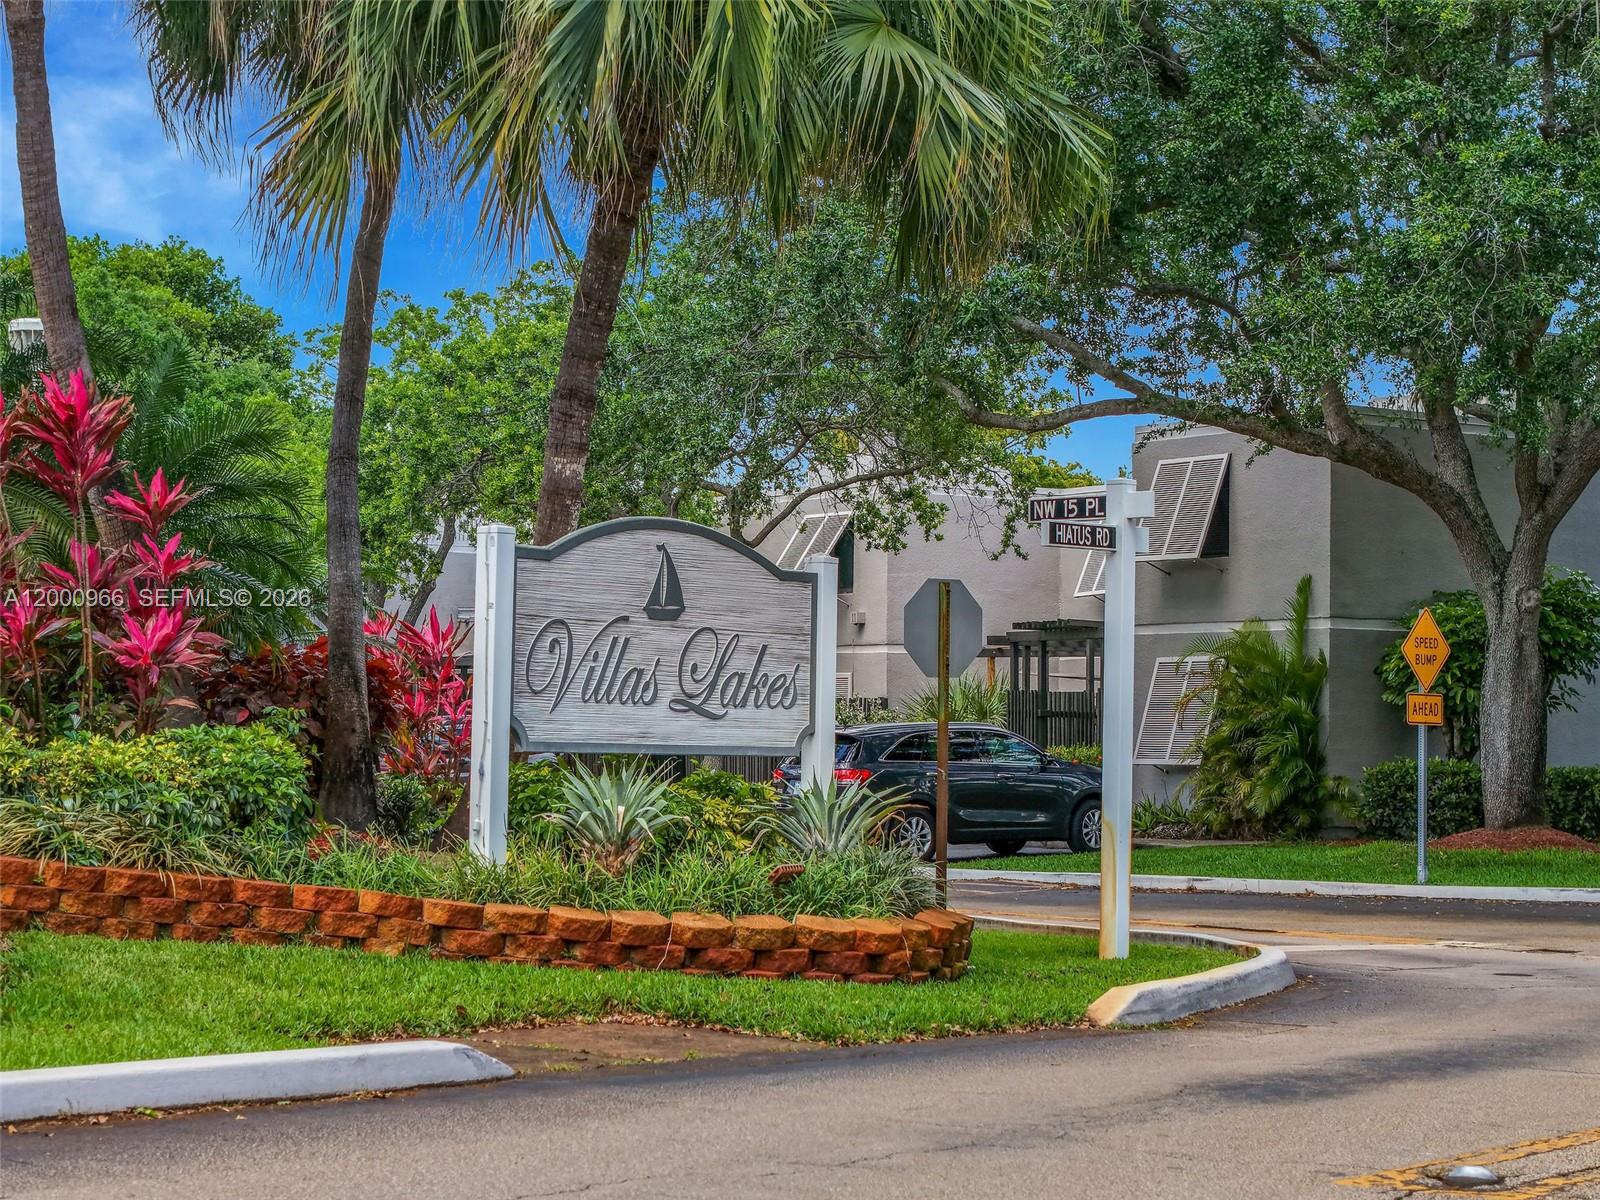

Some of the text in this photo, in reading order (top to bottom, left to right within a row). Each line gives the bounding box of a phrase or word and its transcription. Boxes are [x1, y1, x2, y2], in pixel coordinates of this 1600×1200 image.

[1033, 498, 1104, 518] NW 15 PL
[1056, 524, 1109, 546] HIATUS RD
[1414, 637, 1439, 649] SPEED
[525, 615, 801, 720] Villas Lakes
[1415, 654, 1437, 665] BUMP
[1412, 702, 1438, 716] AHEAD
